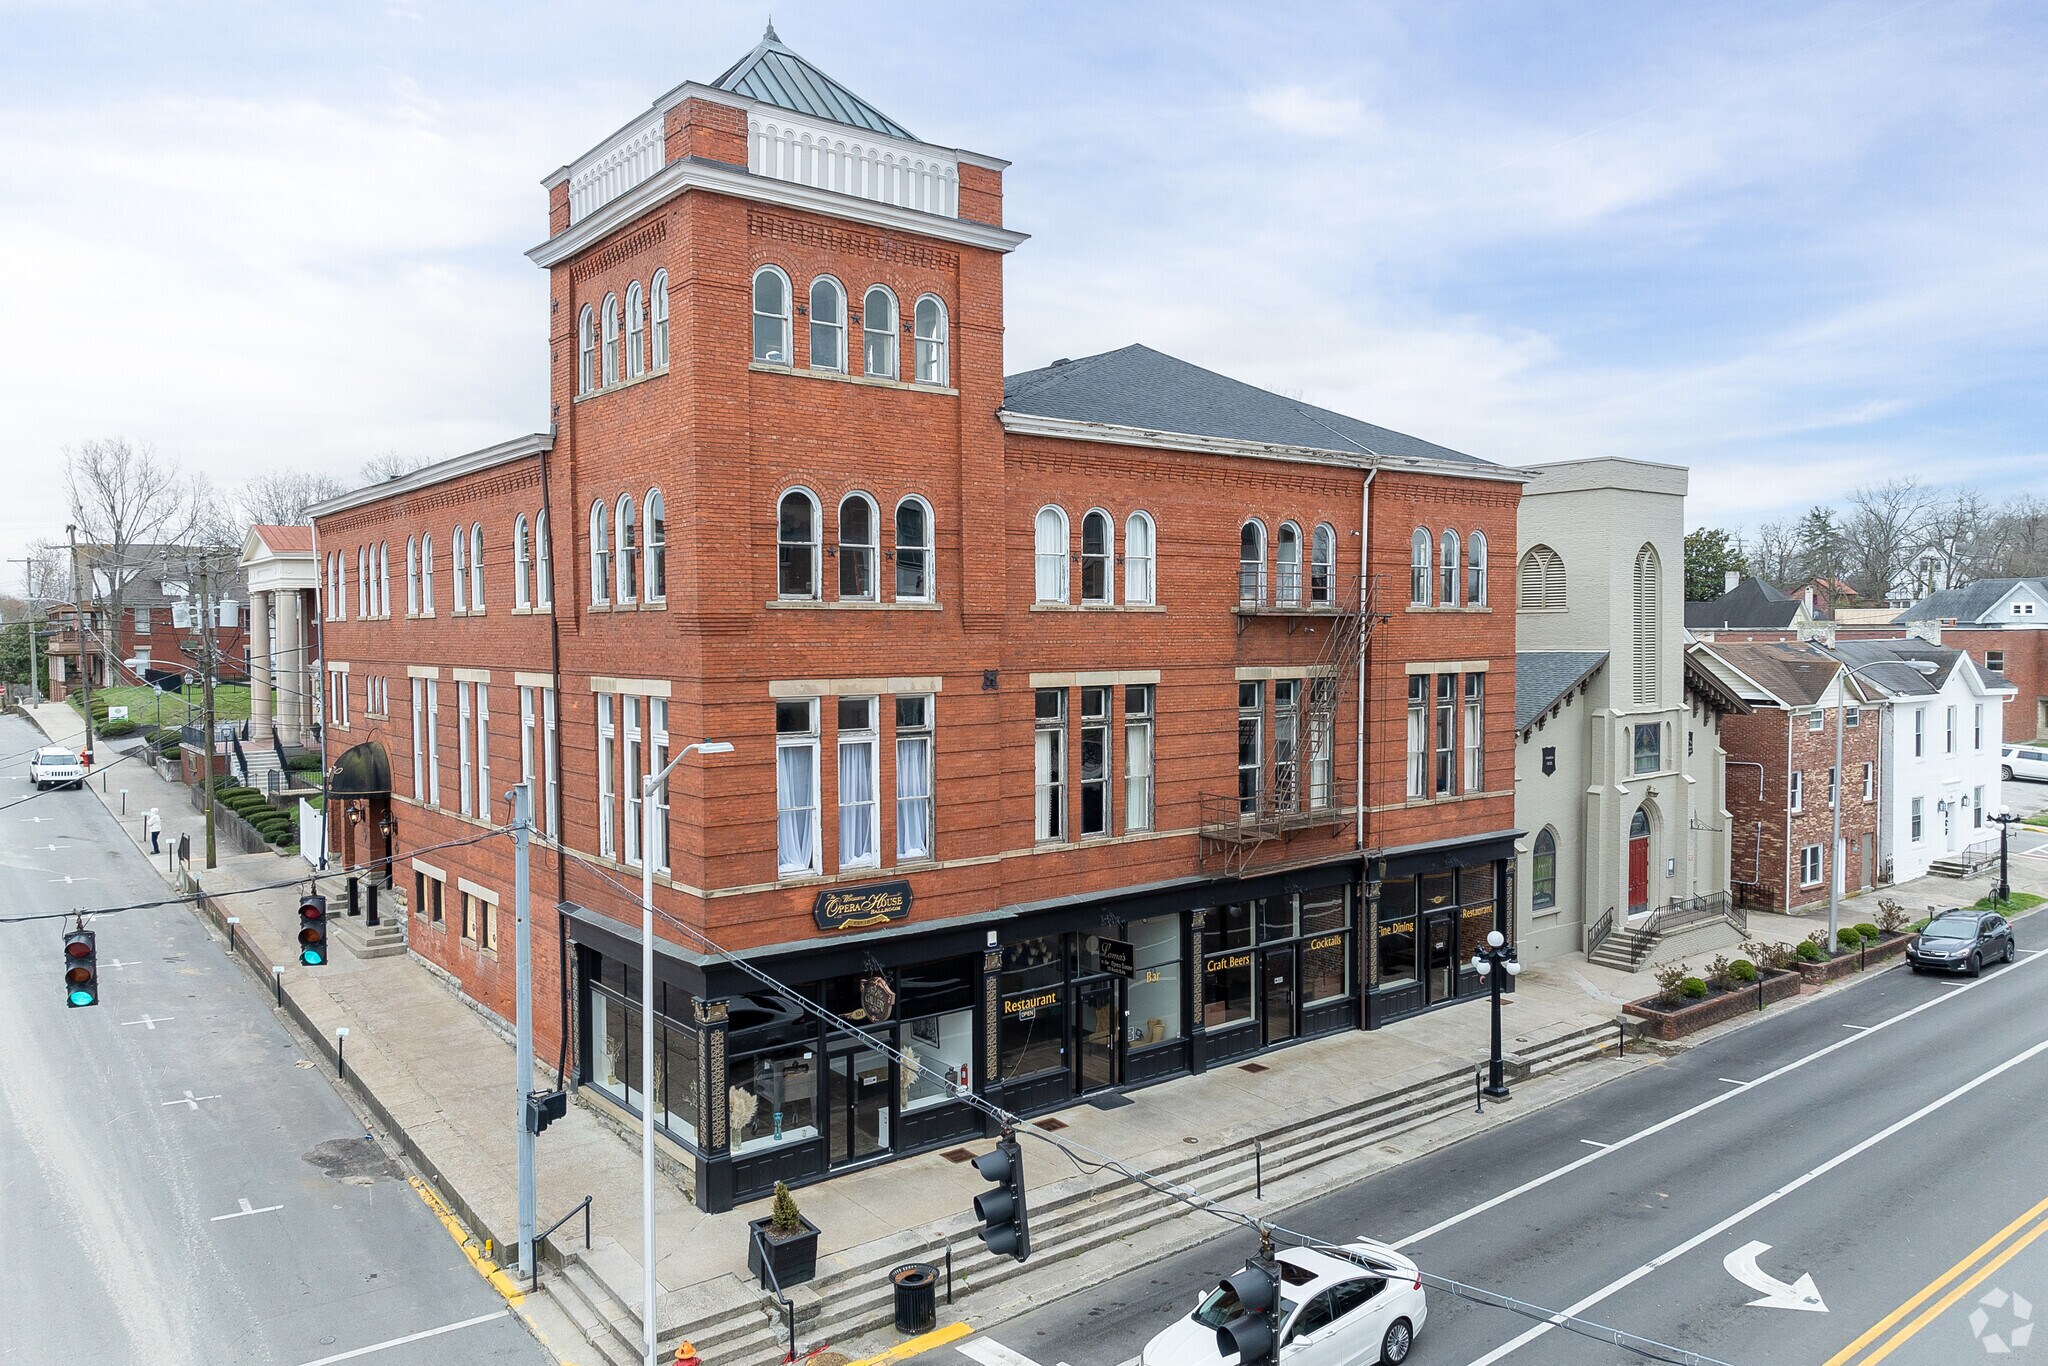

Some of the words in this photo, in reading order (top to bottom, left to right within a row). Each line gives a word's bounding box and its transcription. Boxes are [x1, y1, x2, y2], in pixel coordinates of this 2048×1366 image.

[1462, 905, 1493, 919] Restaurant
[1392, 921, 1414, 934] Dining
[1311, 935, 1342, 950] Cocktails
[1207, 958, 1227, 972] Craft
[1229, 955, 1250, 968] Beers
[1146, 971, 1161, 983] Bar
[1004, 992, 1056, 1014] Restaurant
[1021, 1010, 1034, 1018] OPEN
